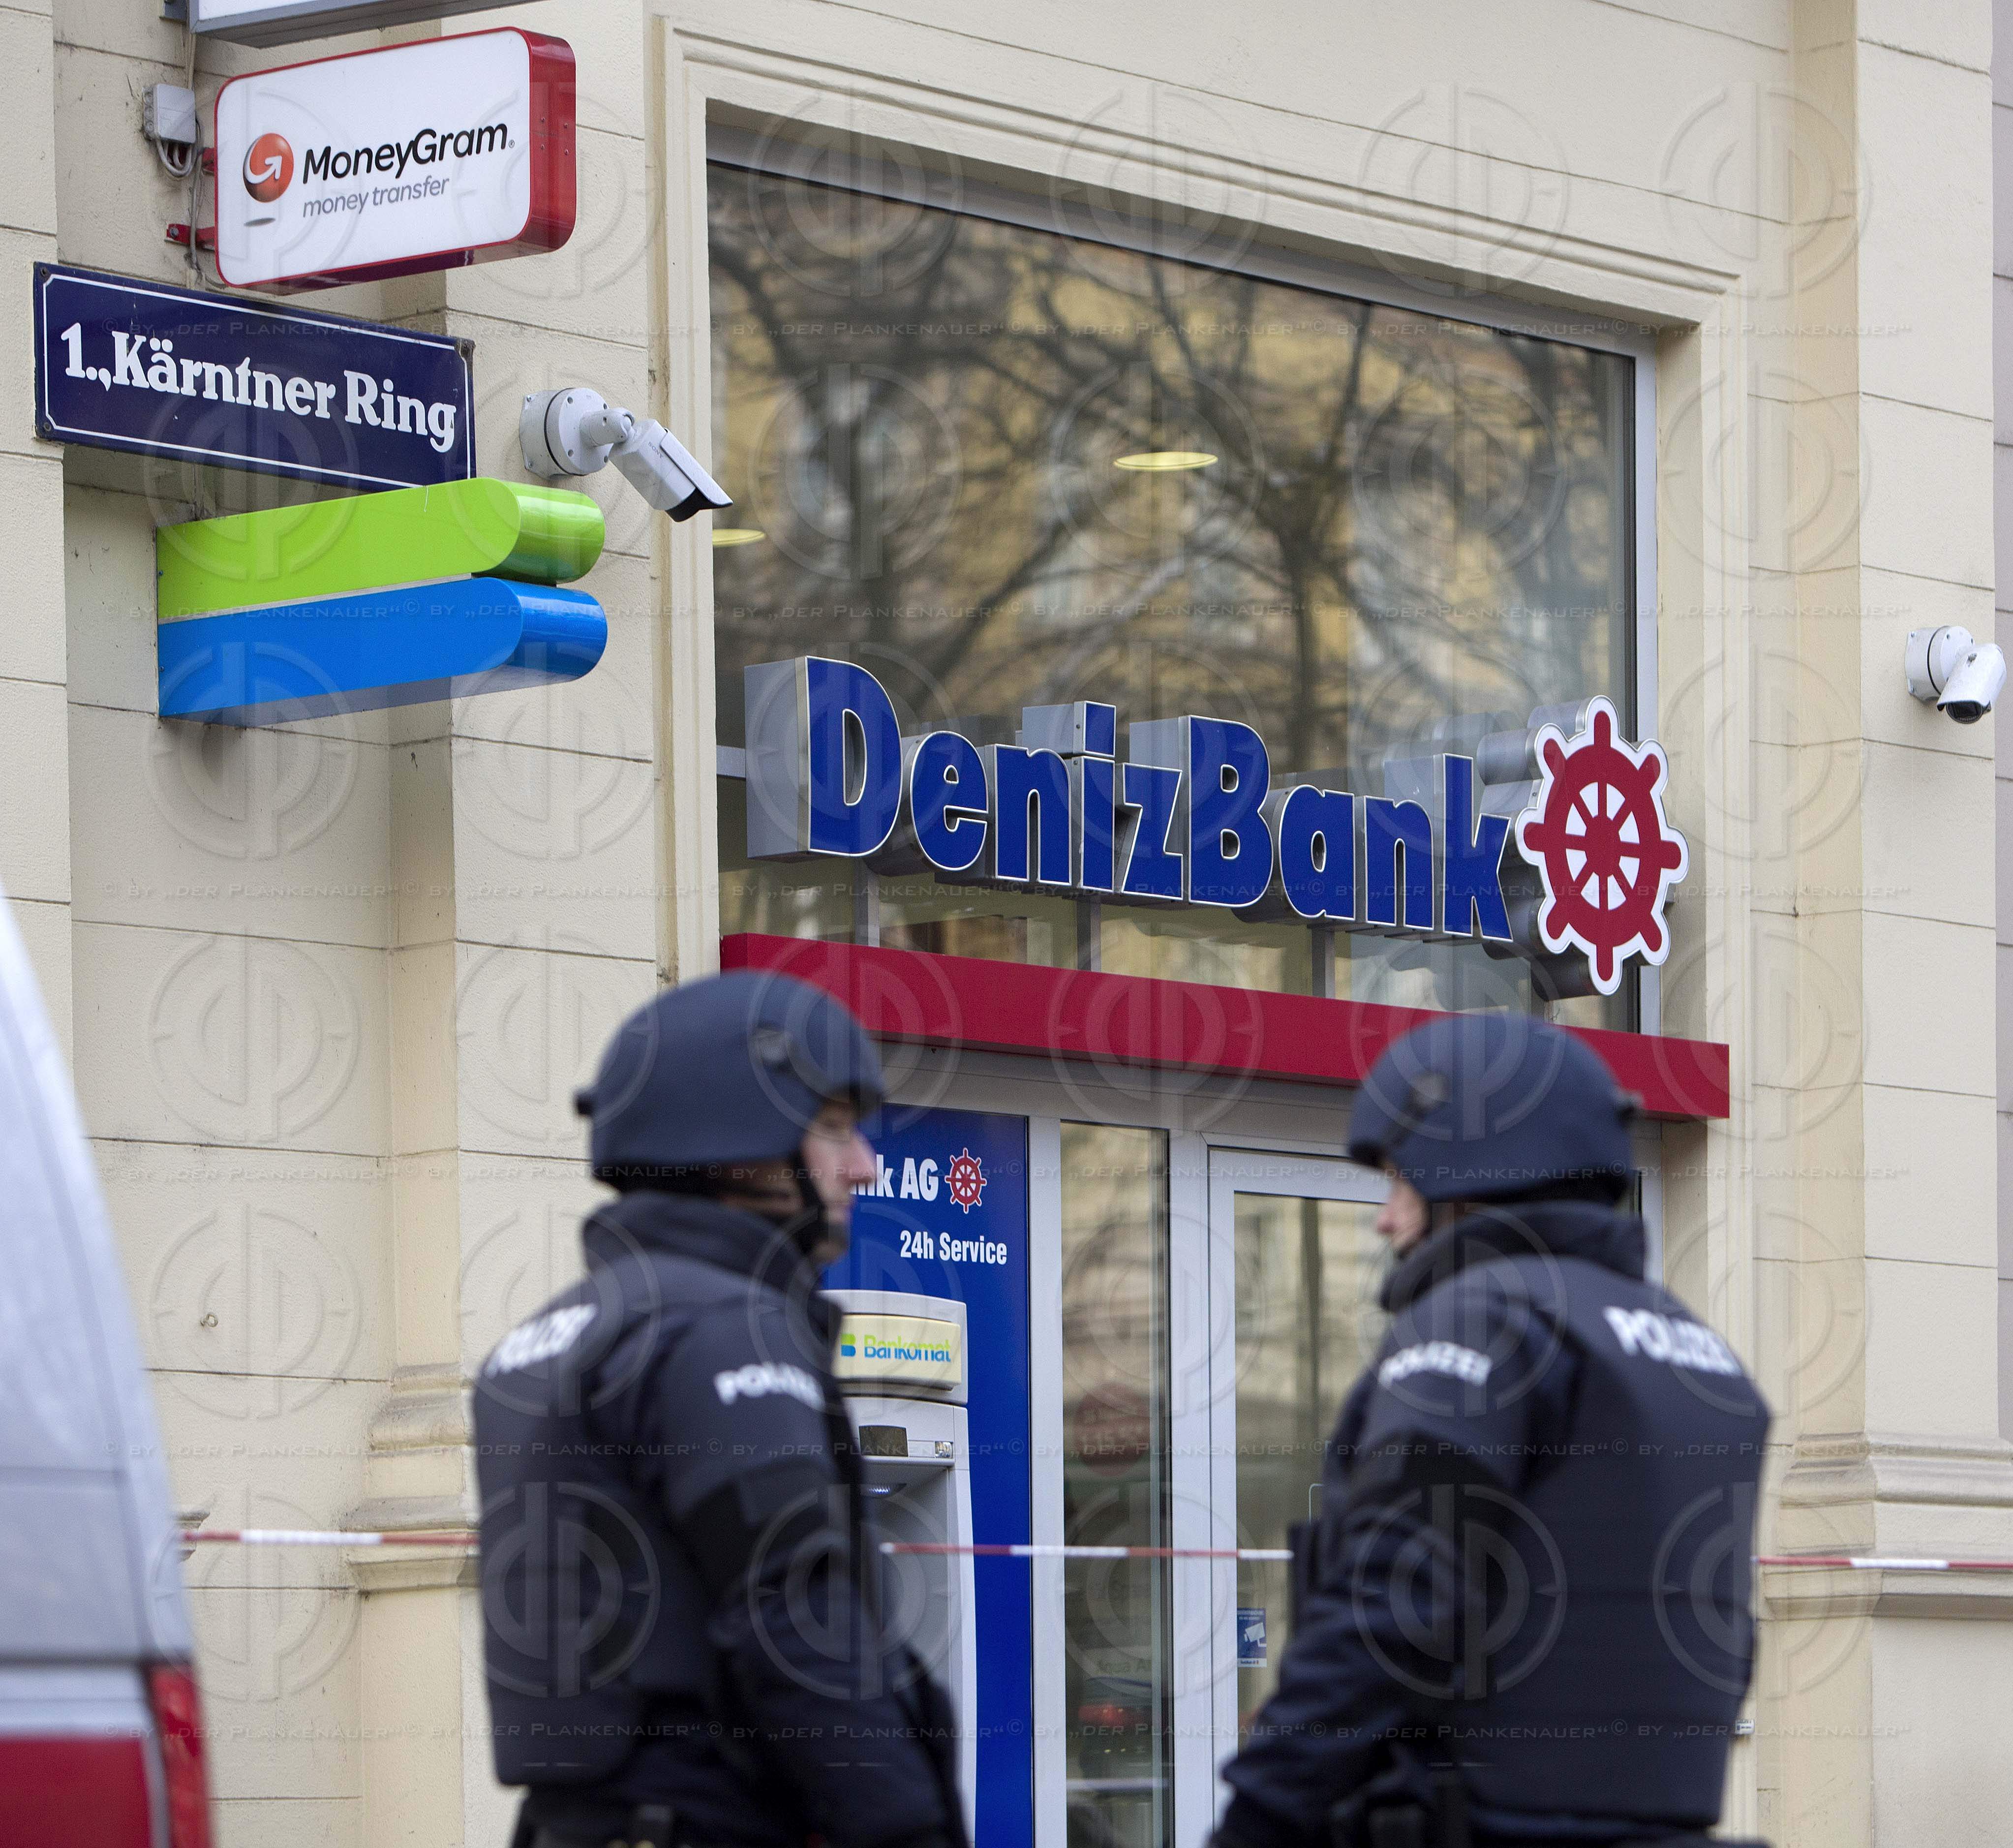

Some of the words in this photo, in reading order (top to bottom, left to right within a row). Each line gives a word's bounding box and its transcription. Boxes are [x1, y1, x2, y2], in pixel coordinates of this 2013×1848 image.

[303, 191, 369, 218] money
[372, 175, 450, 207] transfer
[344, 370, 457, 453] Ring
[648, 440, 664, 459] SONY
[805, 654, 1514, 943] DenizBank
[900, 1157, 939, 1201] AG
[900, 1230, 934, 1260] 24h
[939, 1232, 1008, 1265] Service
[863, 1333, 952, 1363] Bankomat
